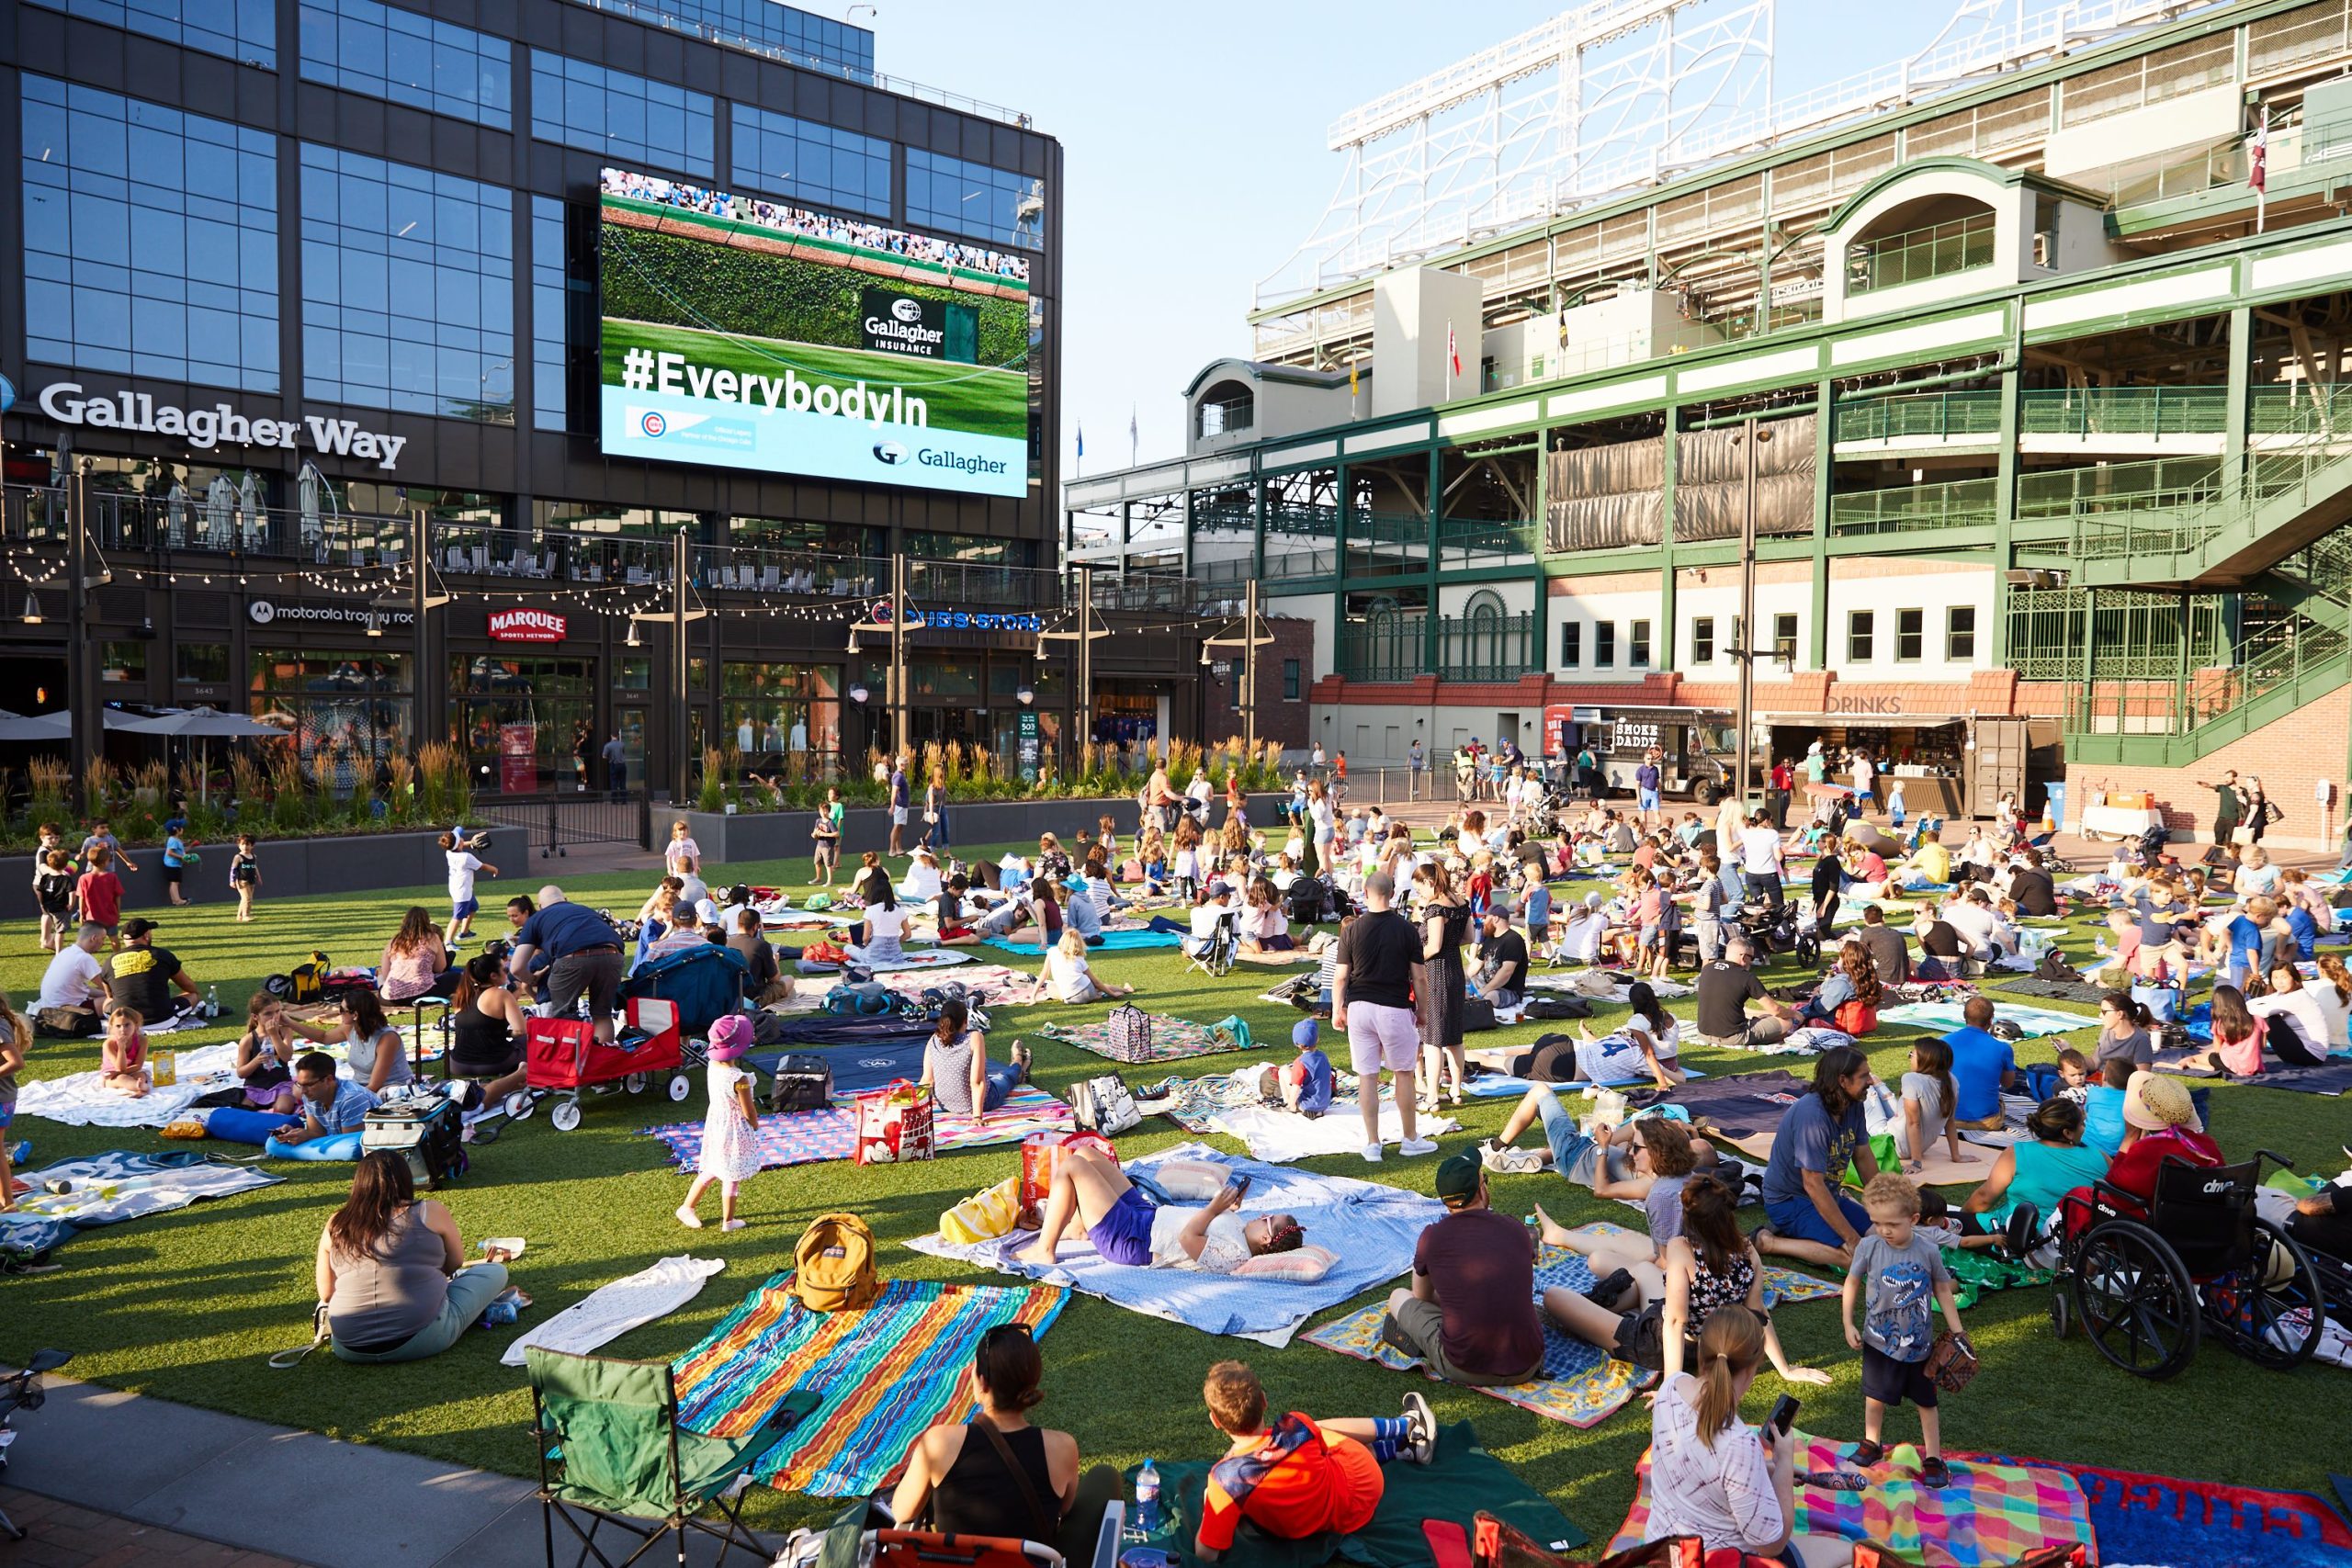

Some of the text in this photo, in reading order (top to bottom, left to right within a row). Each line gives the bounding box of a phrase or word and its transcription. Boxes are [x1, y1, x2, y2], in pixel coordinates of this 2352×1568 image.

[865, 316, 944, 344] Gallagher
[875, 338, 933, 355] INSURANCE
[622, 347, 928, 430] #EverybodyIn
[39, 381, 407, 470] Gallagher Way
[918, 448, 1007, 474] Gallagher
[277, 606, 343, 621] motorola
[491, 611, 565, 633] MARQUEE
[976, 613, 1042, 632] STORE
[194, 687, 214, 695] 3643
[1825, 696, 1901, 715] DRINKS
[1616, 724, 1658, 736] SMOKE
[1616, 735, 1657, 748] DADDY
[1028, 1159, 1038, 1184] Veggies
[1028, 1184, 1036, 1199] Your
[2203, 1179, 2234, 1193] drive
[2098, 1203, 2117, 1217] drive
